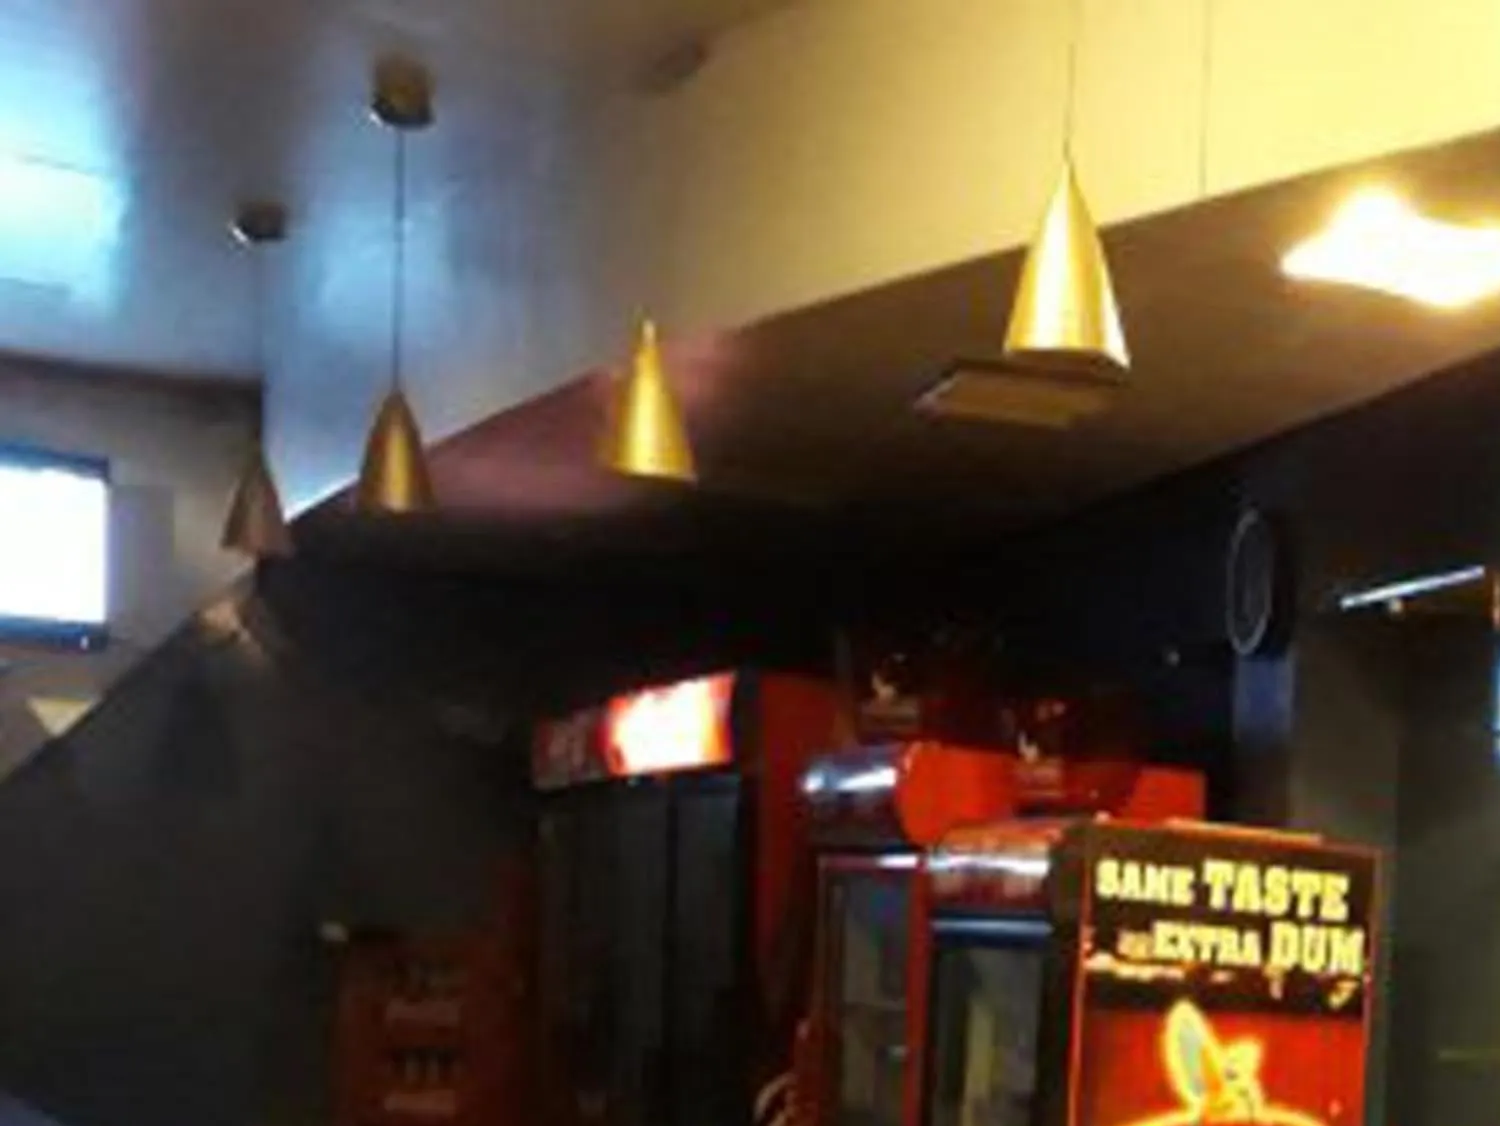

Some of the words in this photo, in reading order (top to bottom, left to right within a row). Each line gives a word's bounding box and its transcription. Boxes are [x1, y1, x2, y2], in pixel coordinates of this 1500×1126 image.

[1096, 860, 1195, 905] SAME
[1203, 858, 1350, 922] TASTE
[1152, 919, 1262, 967] EXTRA
[1270, 920, 1366, 975] DUM
